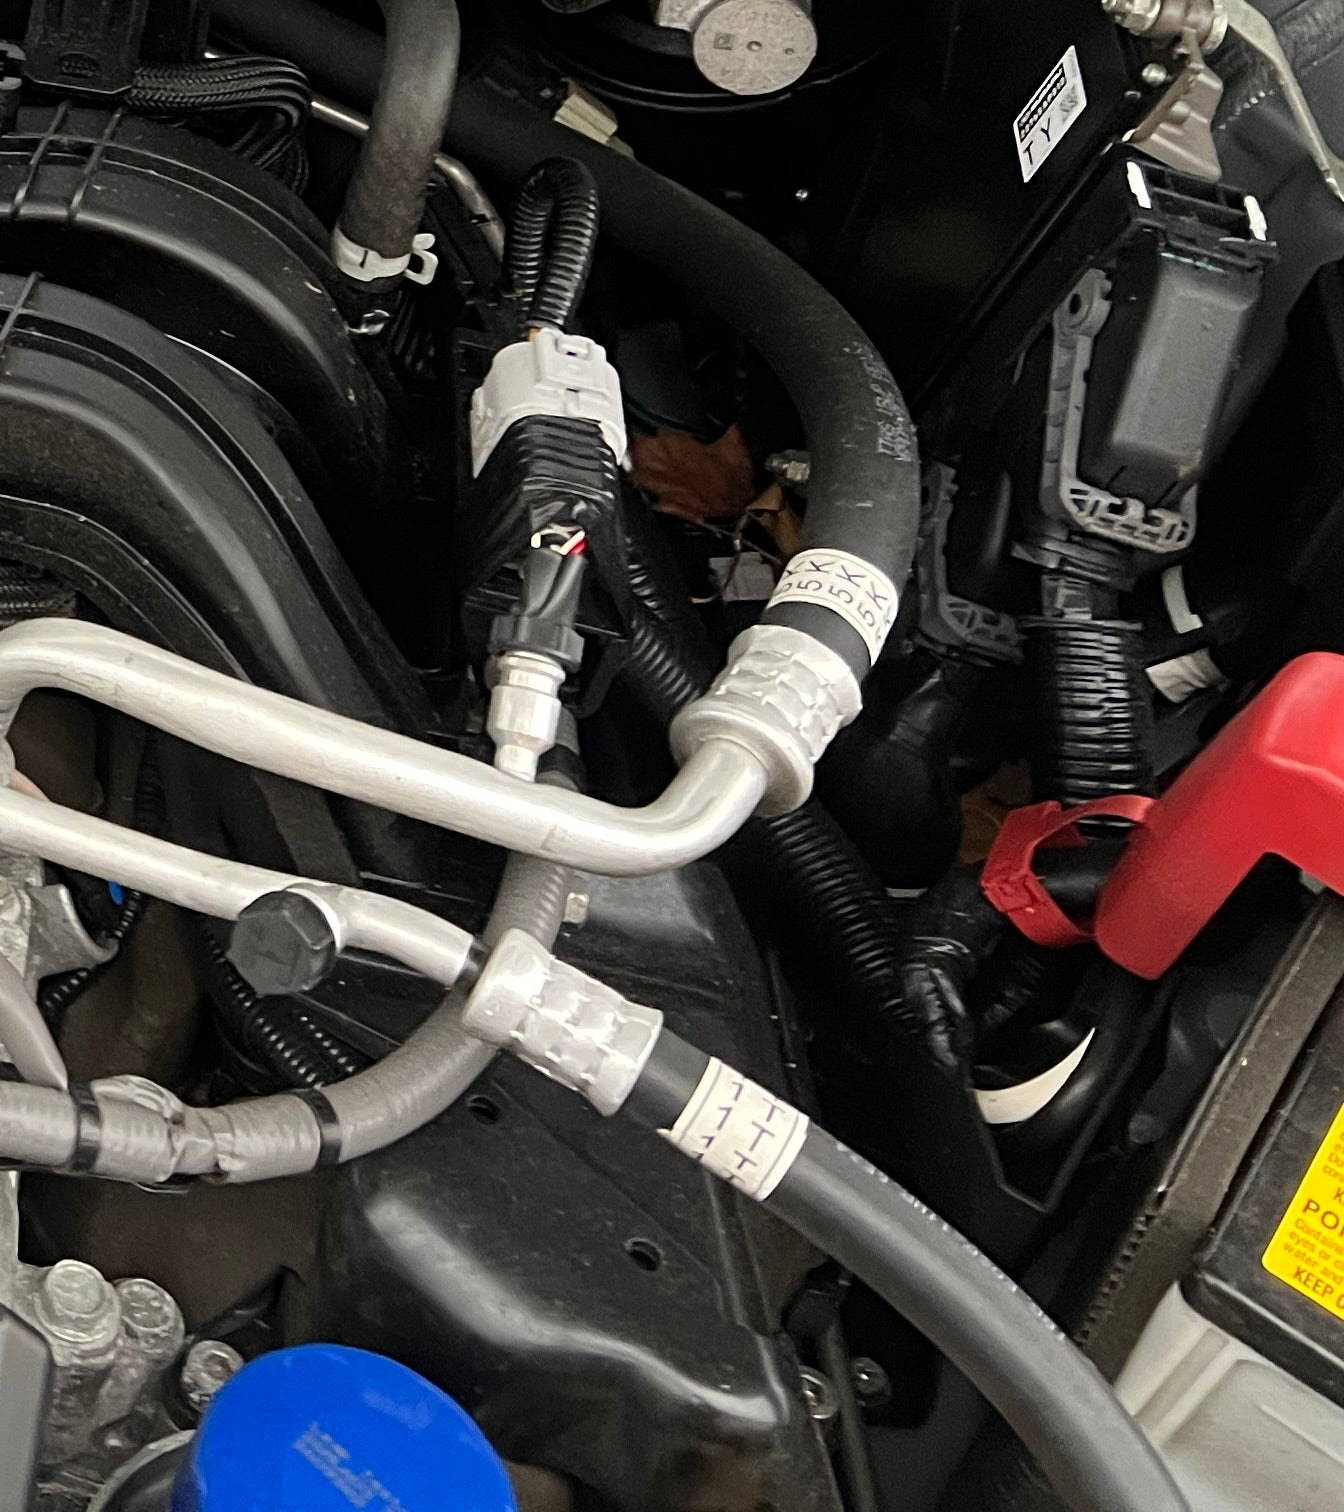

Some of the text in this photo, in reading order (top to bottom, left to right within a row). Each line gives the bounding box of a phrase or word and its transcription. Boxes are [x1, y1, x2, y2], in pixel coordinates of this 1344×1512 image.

[797, 560, 836, 592] 5K
[828, 565, 867, 605] 5K
[856, 581, 889, 627] 5K
[1293, 1265, 1334, 1298] KEEP
